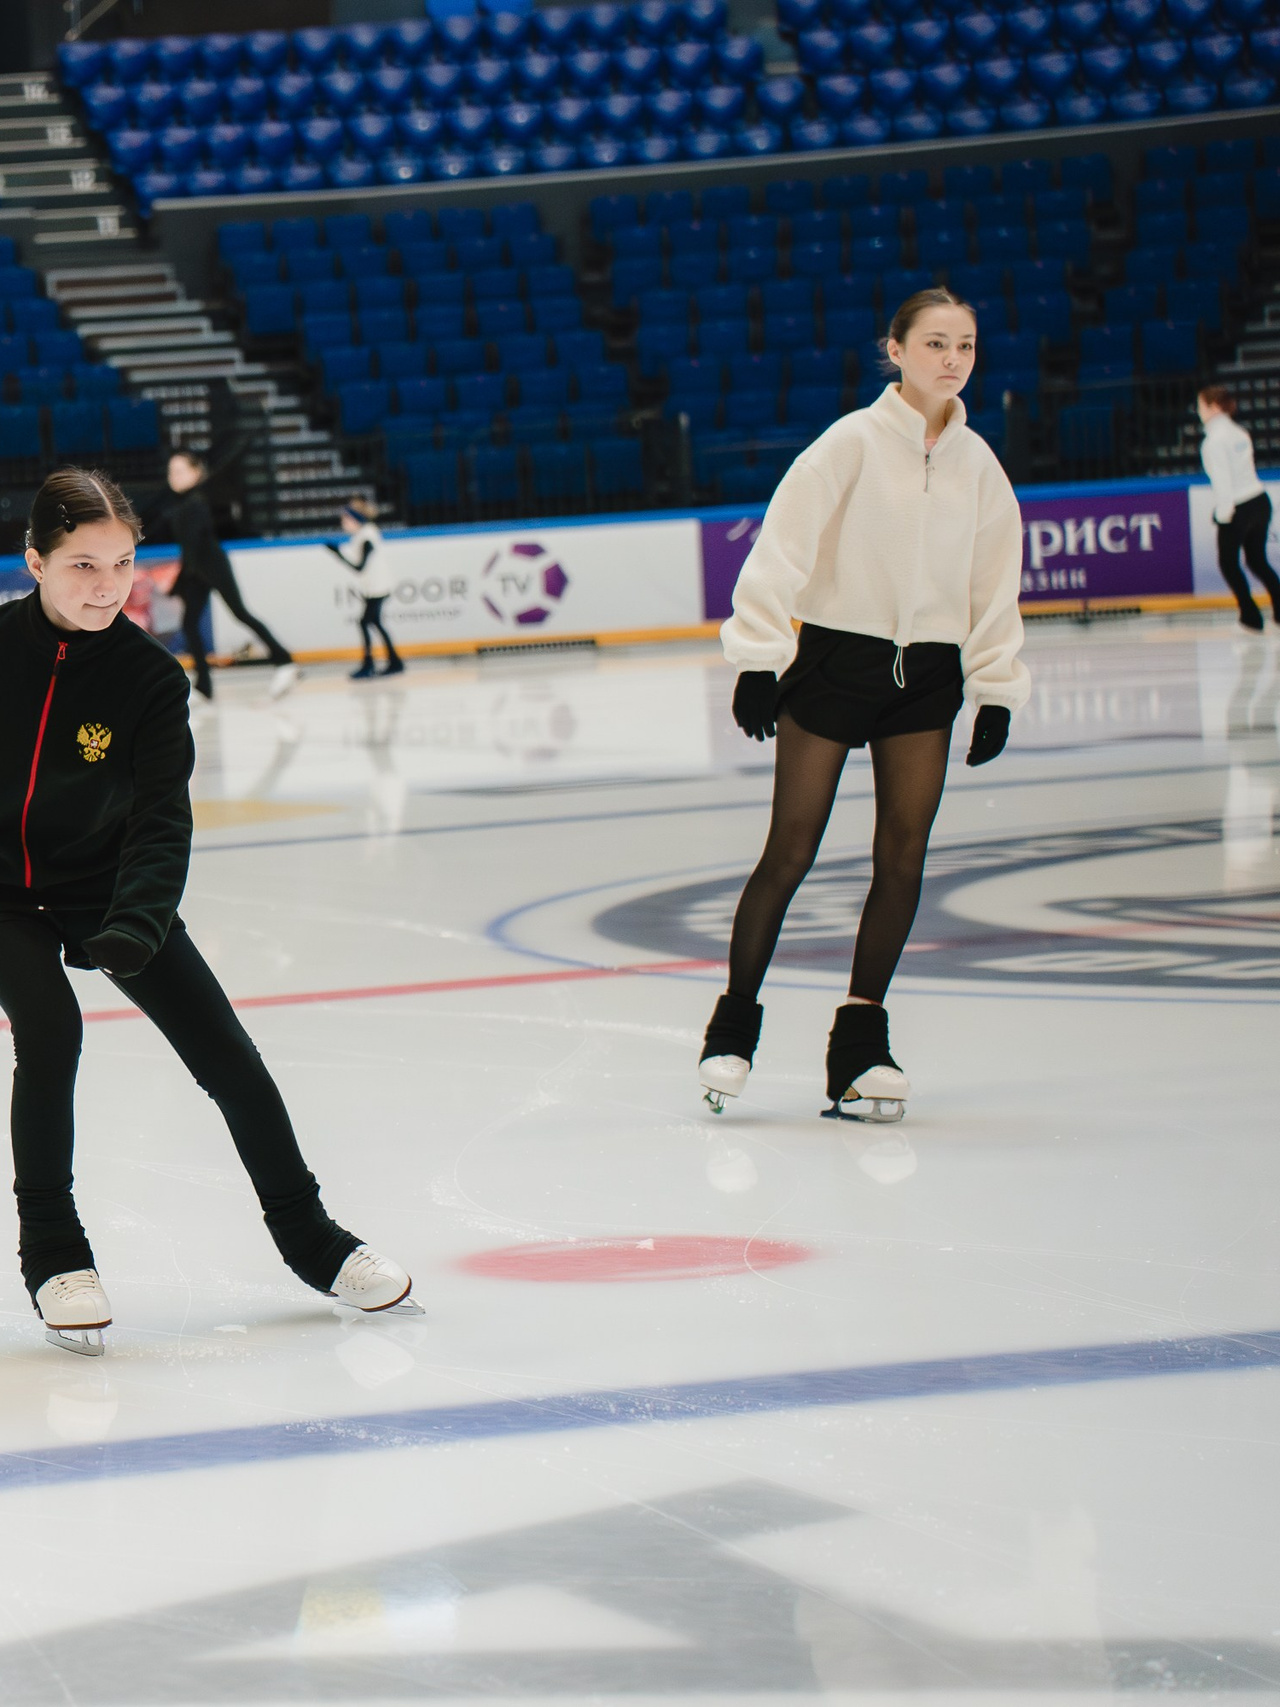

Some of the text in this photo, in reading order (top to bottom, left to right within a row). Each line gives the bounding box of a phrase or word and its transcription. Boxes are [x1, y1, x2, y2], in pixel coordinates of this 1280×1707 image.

[1022, 513, 1162, 569] рист
[334, 574, 533, 607] INOOR TV
